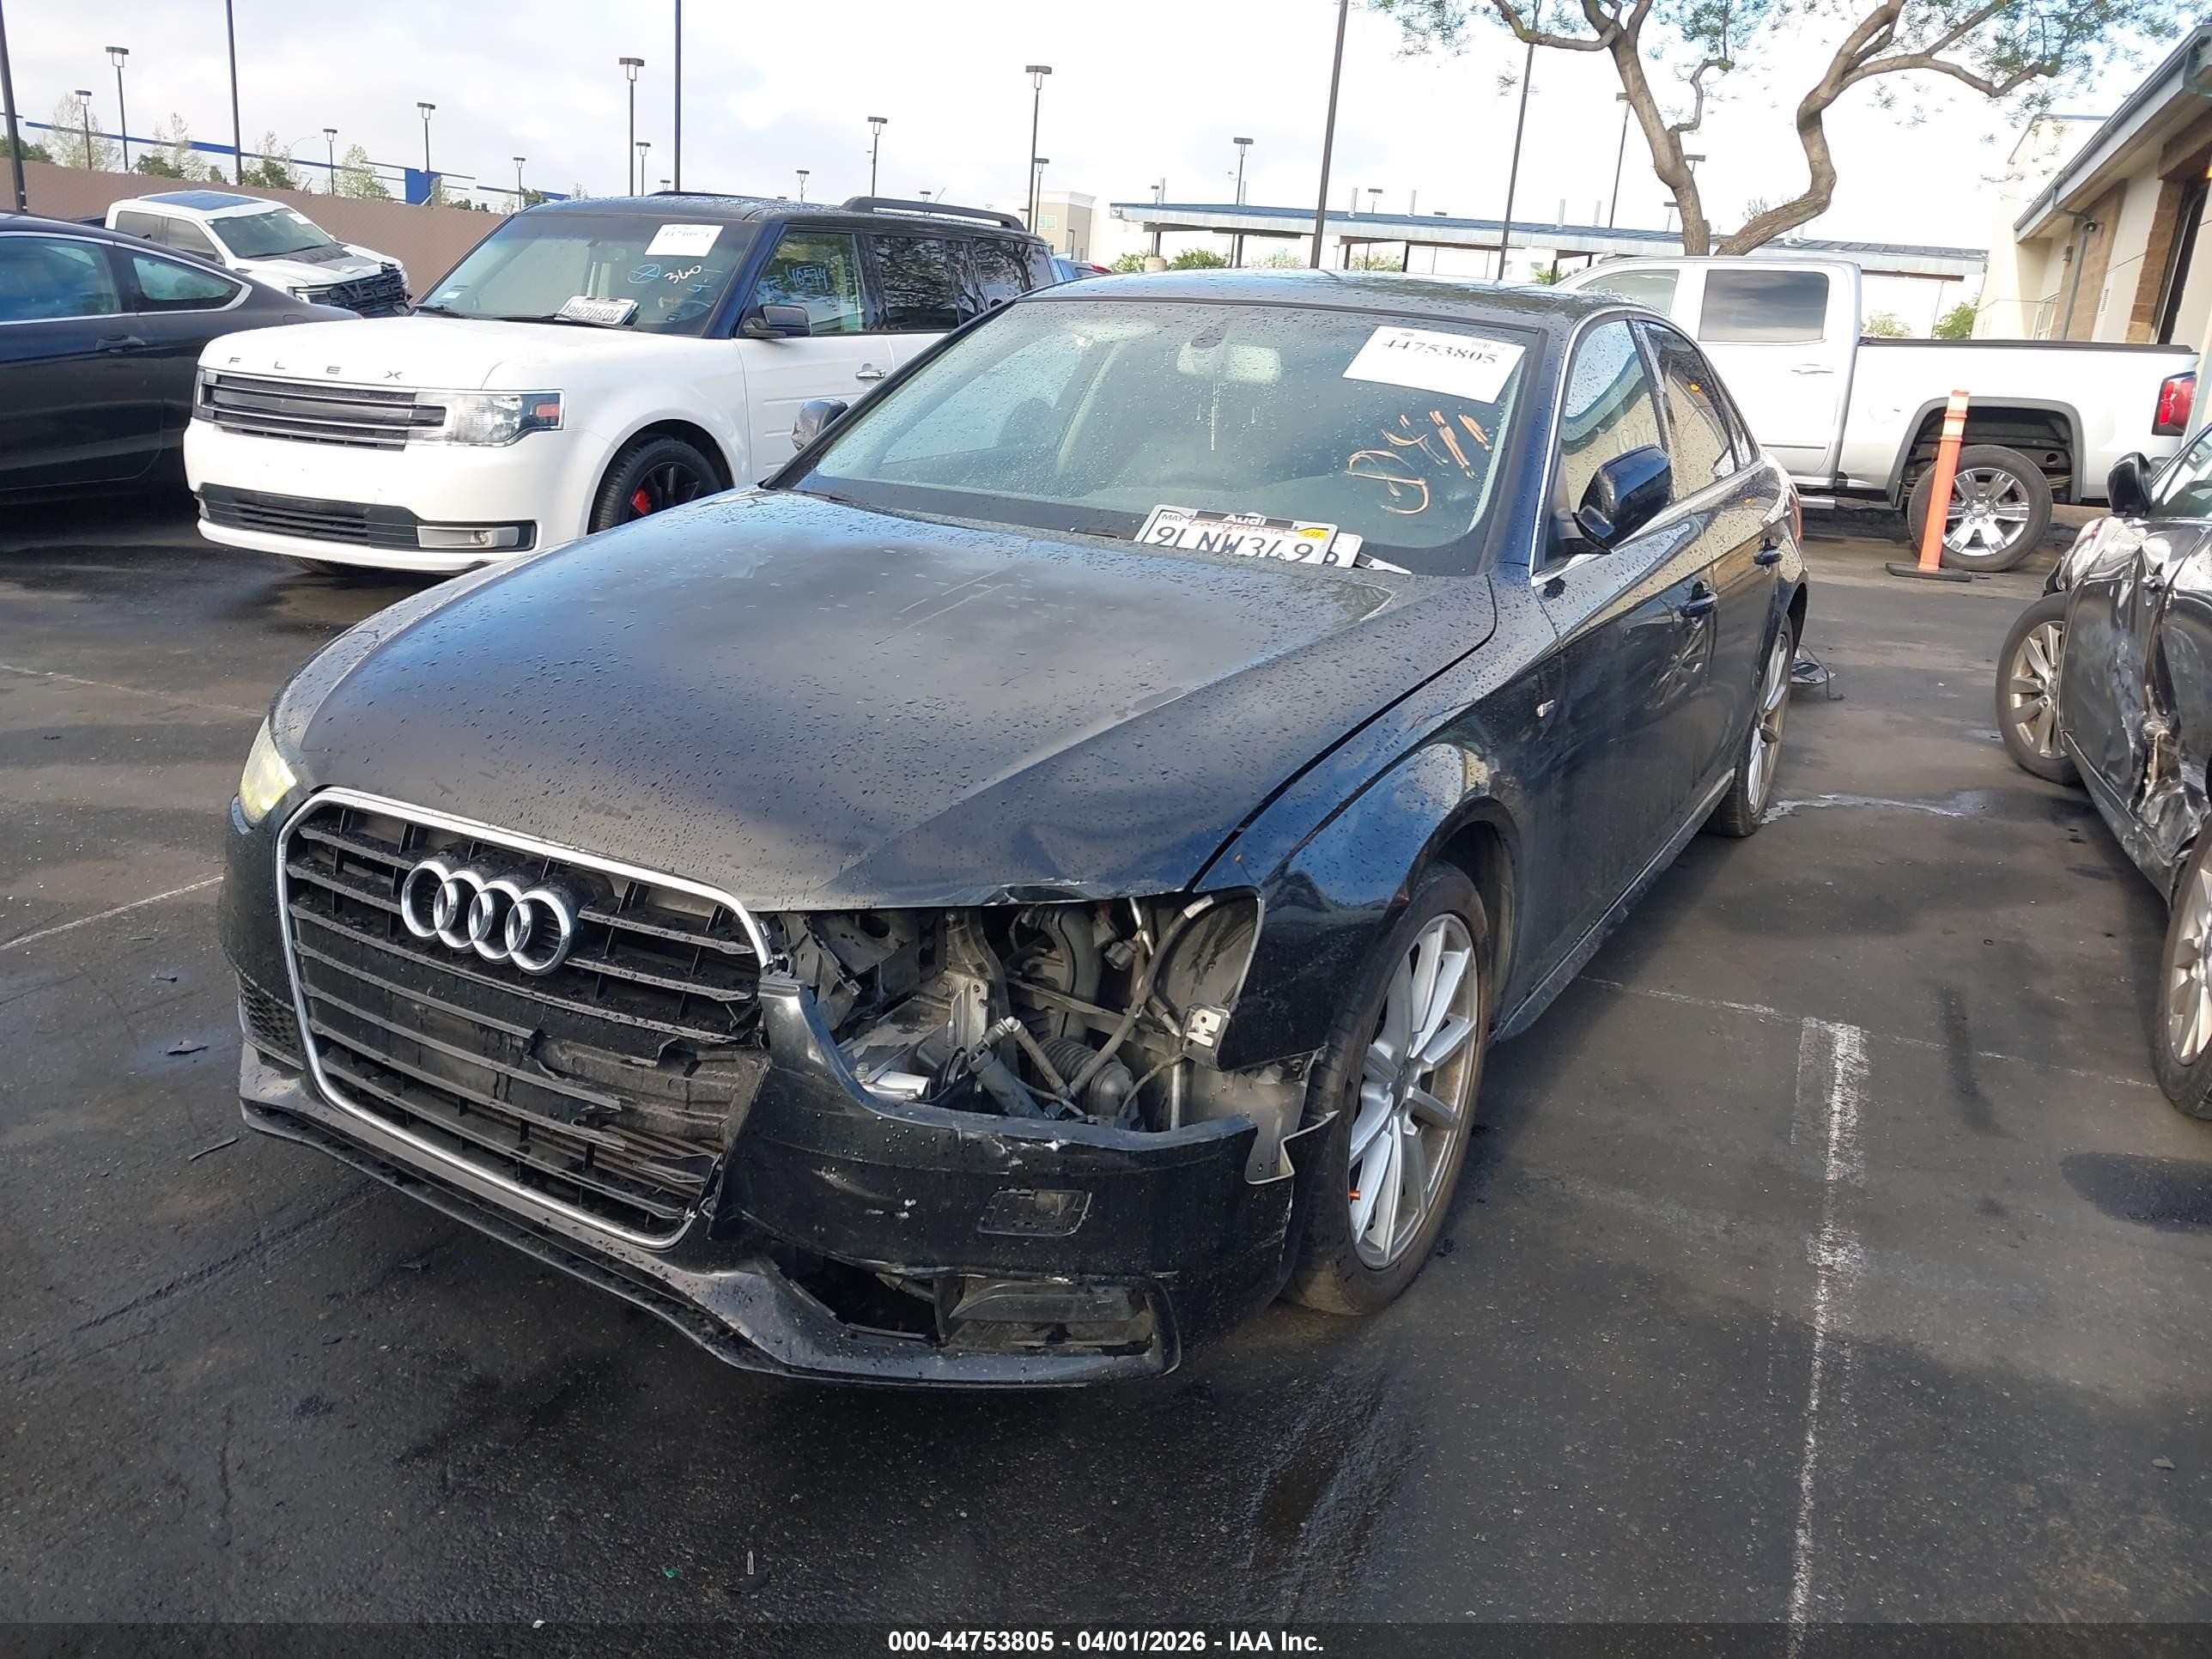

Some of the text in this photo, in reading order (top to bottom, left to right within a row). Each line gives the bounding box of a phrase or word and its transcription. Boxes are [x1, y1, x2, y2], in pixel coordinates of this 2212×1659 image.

[1382, 338, 1498, 364] 44753805
[228, 356, 403, 380] FLEX
[1222, 514, 1266, 526] Audi
